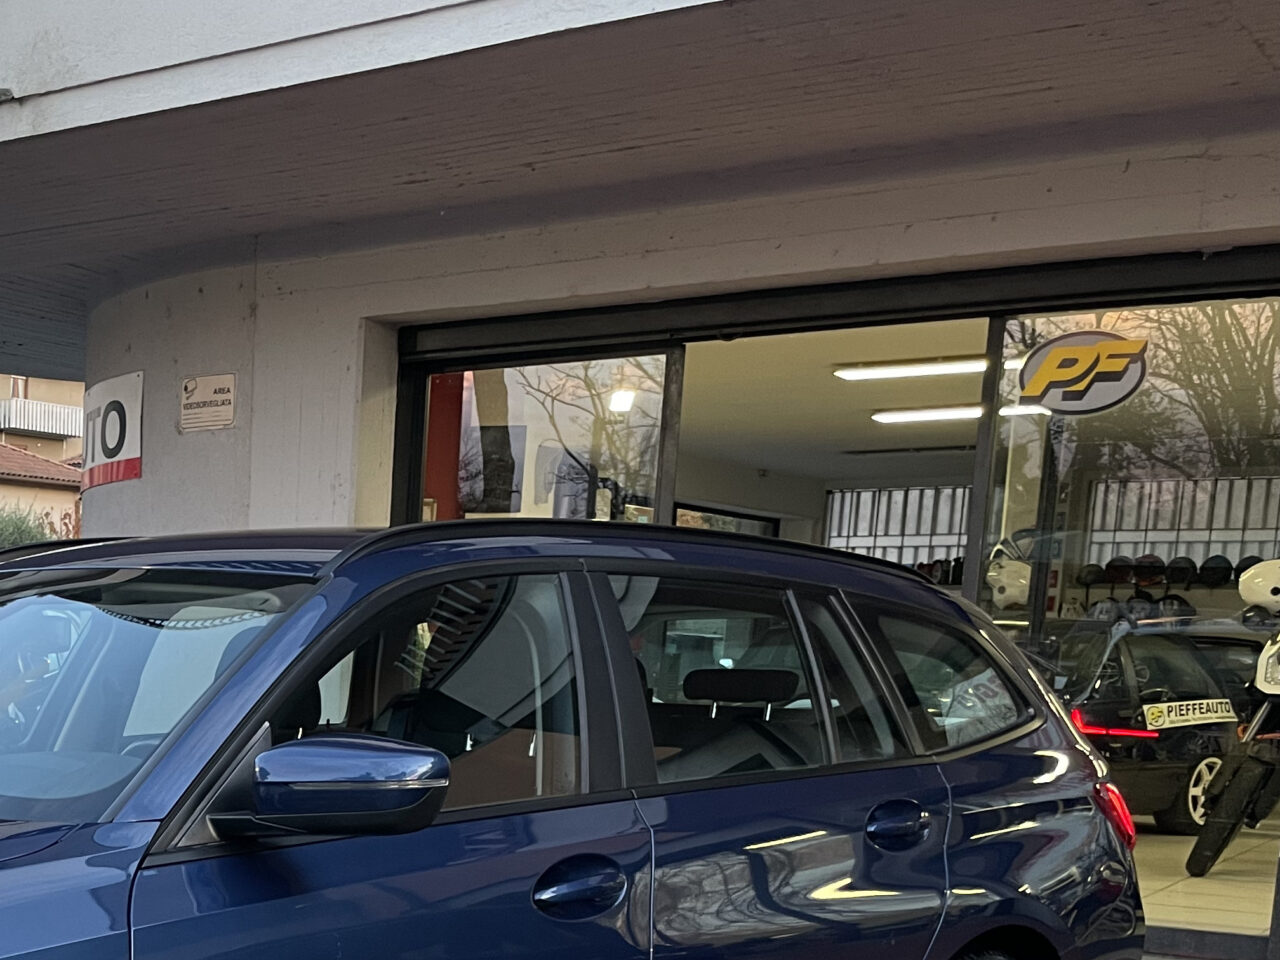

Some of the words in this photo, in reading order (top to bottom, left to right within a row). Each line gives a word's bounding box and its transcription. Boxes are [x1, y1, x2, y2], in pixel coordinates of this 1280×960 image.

[213, 386, 231, 395] AREA
[84, 399, 127, 464] TO
[1167, 701, 1231, 718] PIEFFEAUTO
